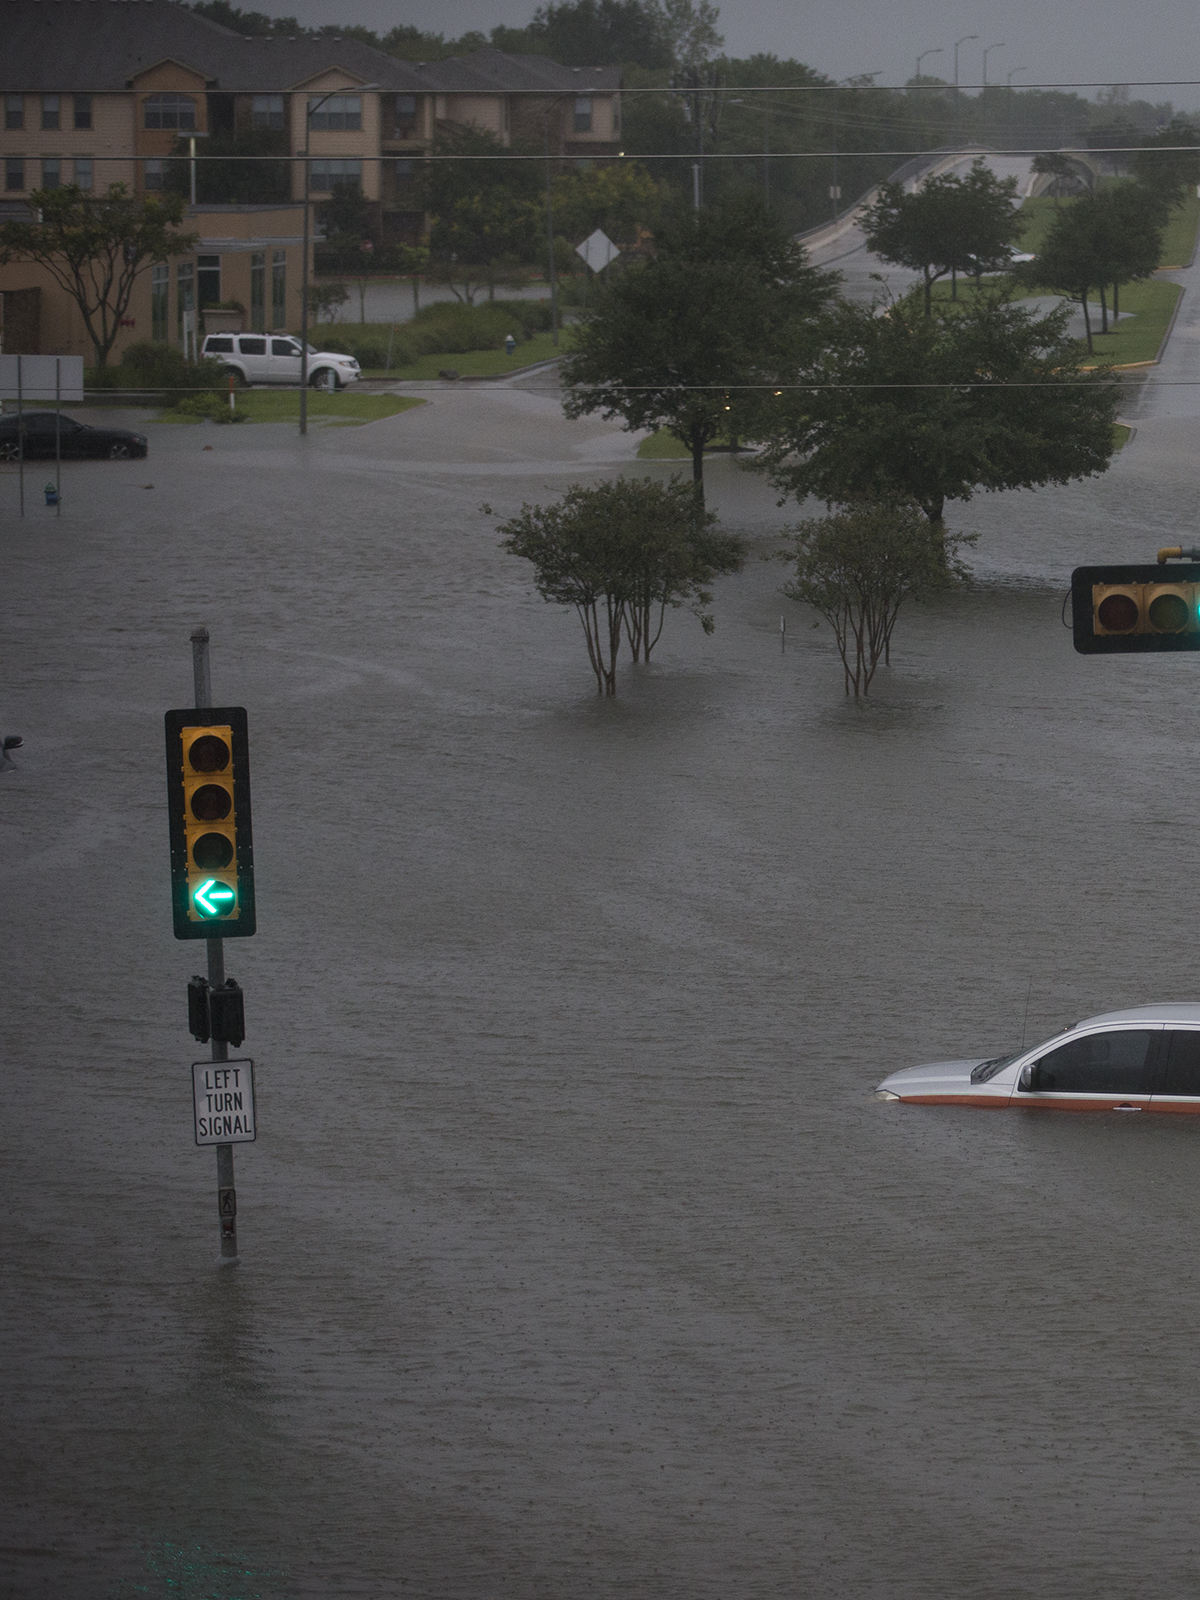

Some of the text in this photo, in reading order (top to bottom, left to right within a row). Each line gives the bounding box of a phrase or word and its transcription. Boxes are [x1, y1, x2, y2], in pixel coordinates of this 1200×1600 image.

[205, 1069, 240, 1089] LEFT
[206, 1092, 243, 1112] TURN
[199, 1115, 252, 1136] SIGNAL
